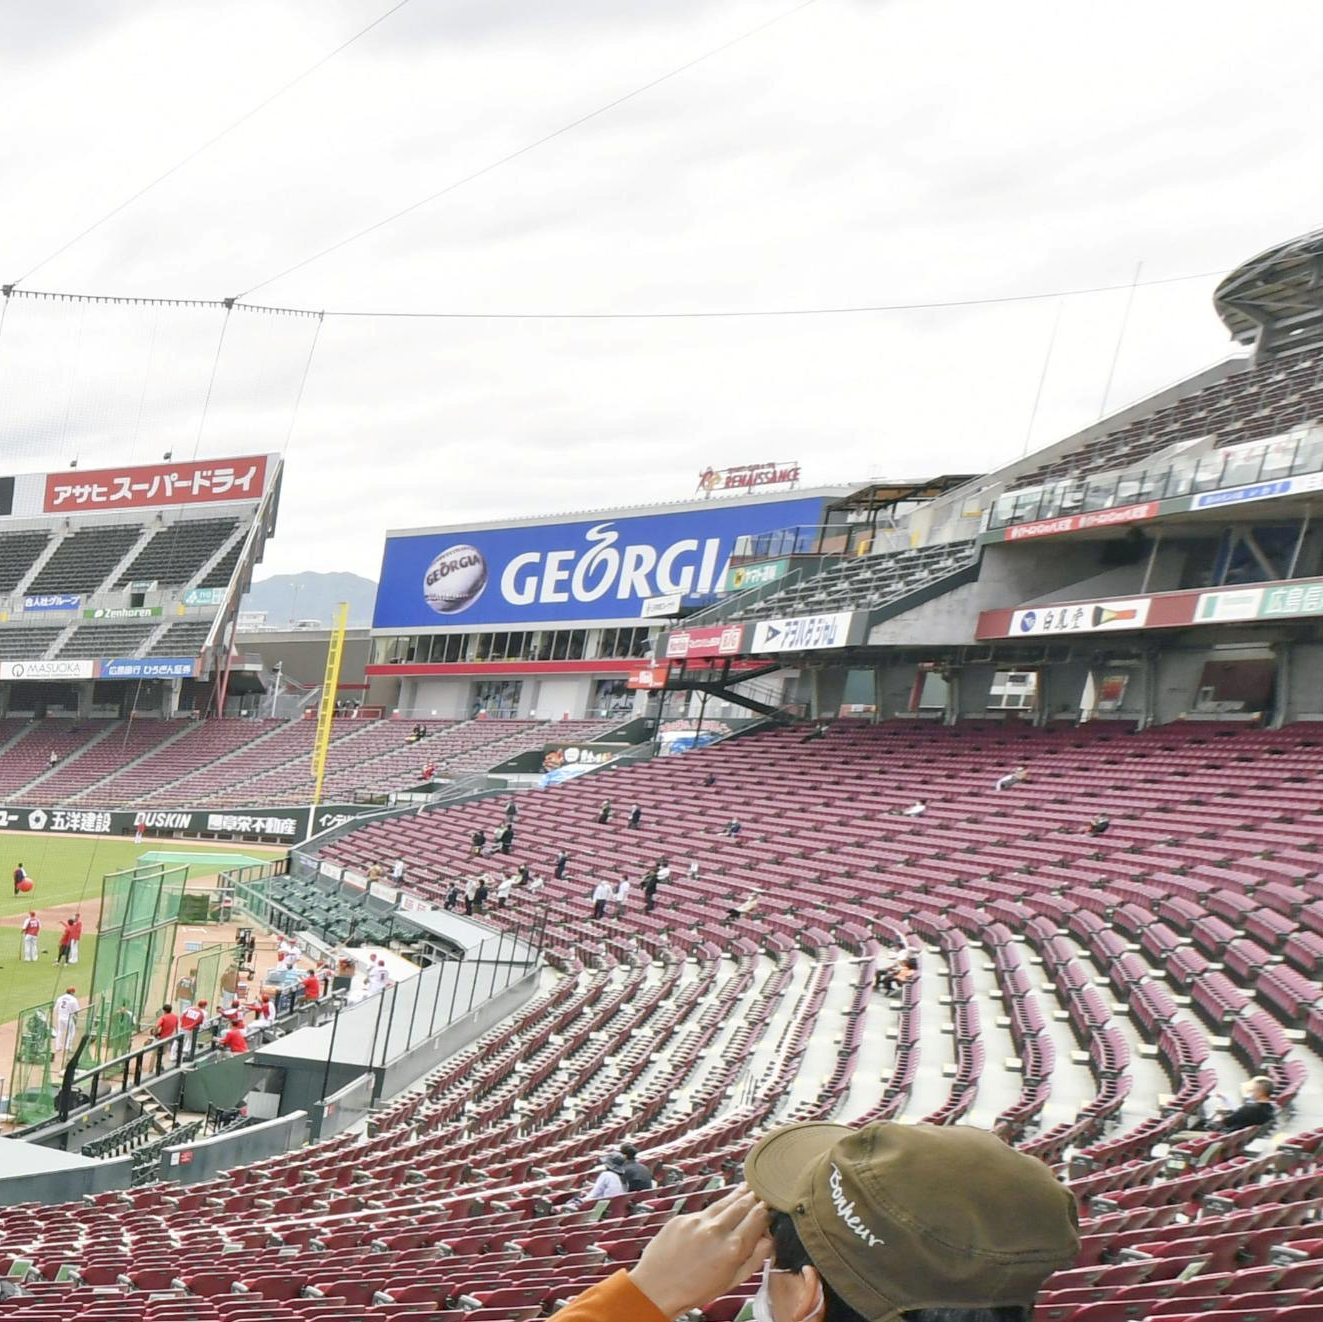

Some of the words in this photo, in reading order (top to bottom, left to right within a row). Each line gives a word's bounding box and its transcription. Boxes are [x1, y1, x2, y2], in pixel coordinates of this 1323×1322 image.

[725, 468, 801, 488] RENAISSANCE
[104, 607, 152, 618] Zenhoren
[50, 811, 111, 832] 五洋建設
[133, 812, 193, 829] DUSKIN
[223, 815, 298, 835] 章栄不動産
[829, 1161, 886, 1248] Bonheur
